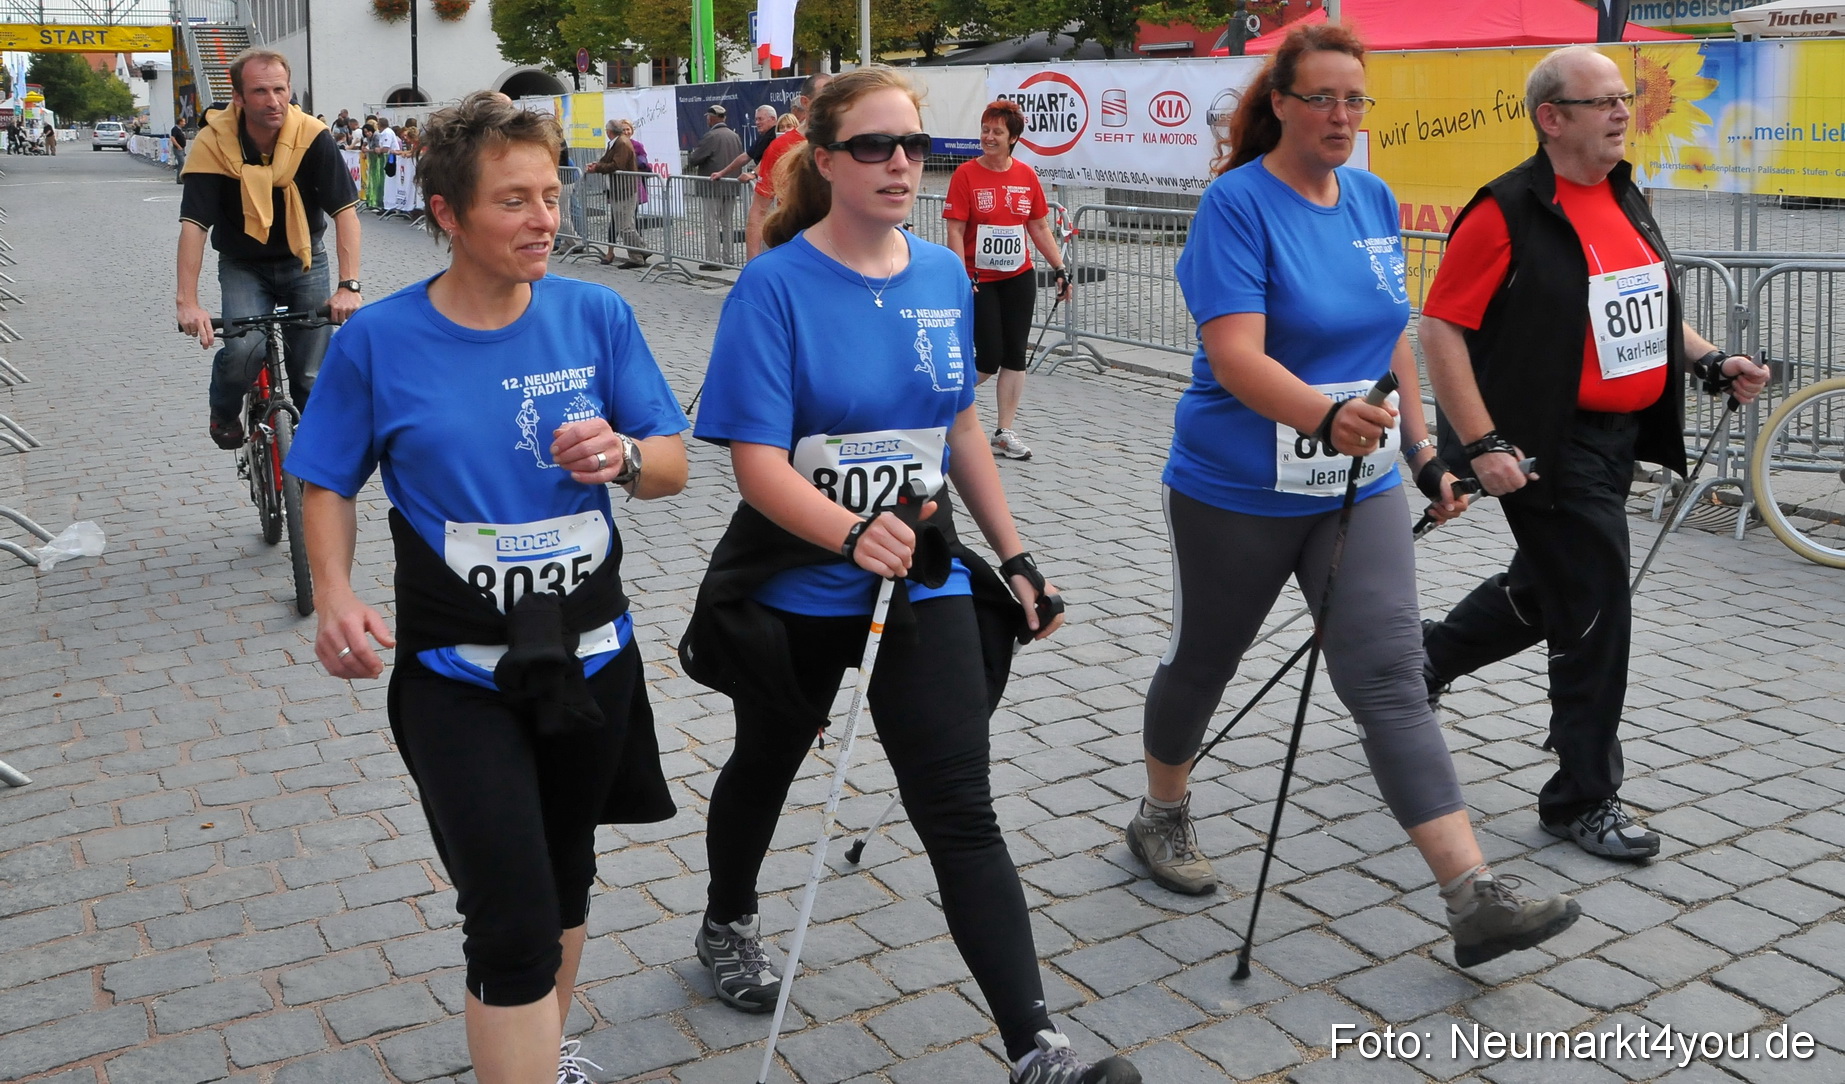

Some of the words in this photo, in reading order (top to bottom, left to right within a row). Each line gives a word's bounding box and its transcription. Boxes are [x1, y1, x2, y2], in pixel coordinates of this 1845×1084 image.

[1768, 10, 1838, 27] Tucher
[40, 30, 108, 45] START
[1069, 97, 1075, 108] &
[1156, 100, 1185, 118] KIA
[1028, 113, 1078, 132] JÄNIG
[1379, 123, 1410, 149] wir
[1416, 109, 1486, 140] bauen
[1492, 89, 1526, 123] für
[1094, 133, 1135, 142] SEAT
[1142, 132, 1157, 144] KIA
[1159, 133, 1198, 145] MOTORS
[1034, 166, 1076, 180] Sengenthal
[1081, 167, 1094, 180] Tel.
[1095, 169, 1130, 183] 09181/26
[1130, 172, 1150, 185] 80-0
[1703, 163, 1751, 173] Außenplatten
[1757, 165, 1795, 175] Palisaden
[1802, 168, 1828, 176] Stufen
[982, 237, 1021, 255] 8008
[989, 258, 1014, 266] Andrea
[1617, 273, 1650, 290] BOCK
[899, 309, 916, 318] 12.
[916, 308, 961, 318] NEUMARKTER
[1604, 291, 1663, 338] 8017
[917, 318, 956, 327] STADTLAUF
[502, 378, 523, 390] 12.
[523, 379, 588, 398] STADTLAUF
[839, 439, 901, 456] BOCK
[1306, 462, 1375, 486] Jeante
[497, 529, 560, 551] BOCK
